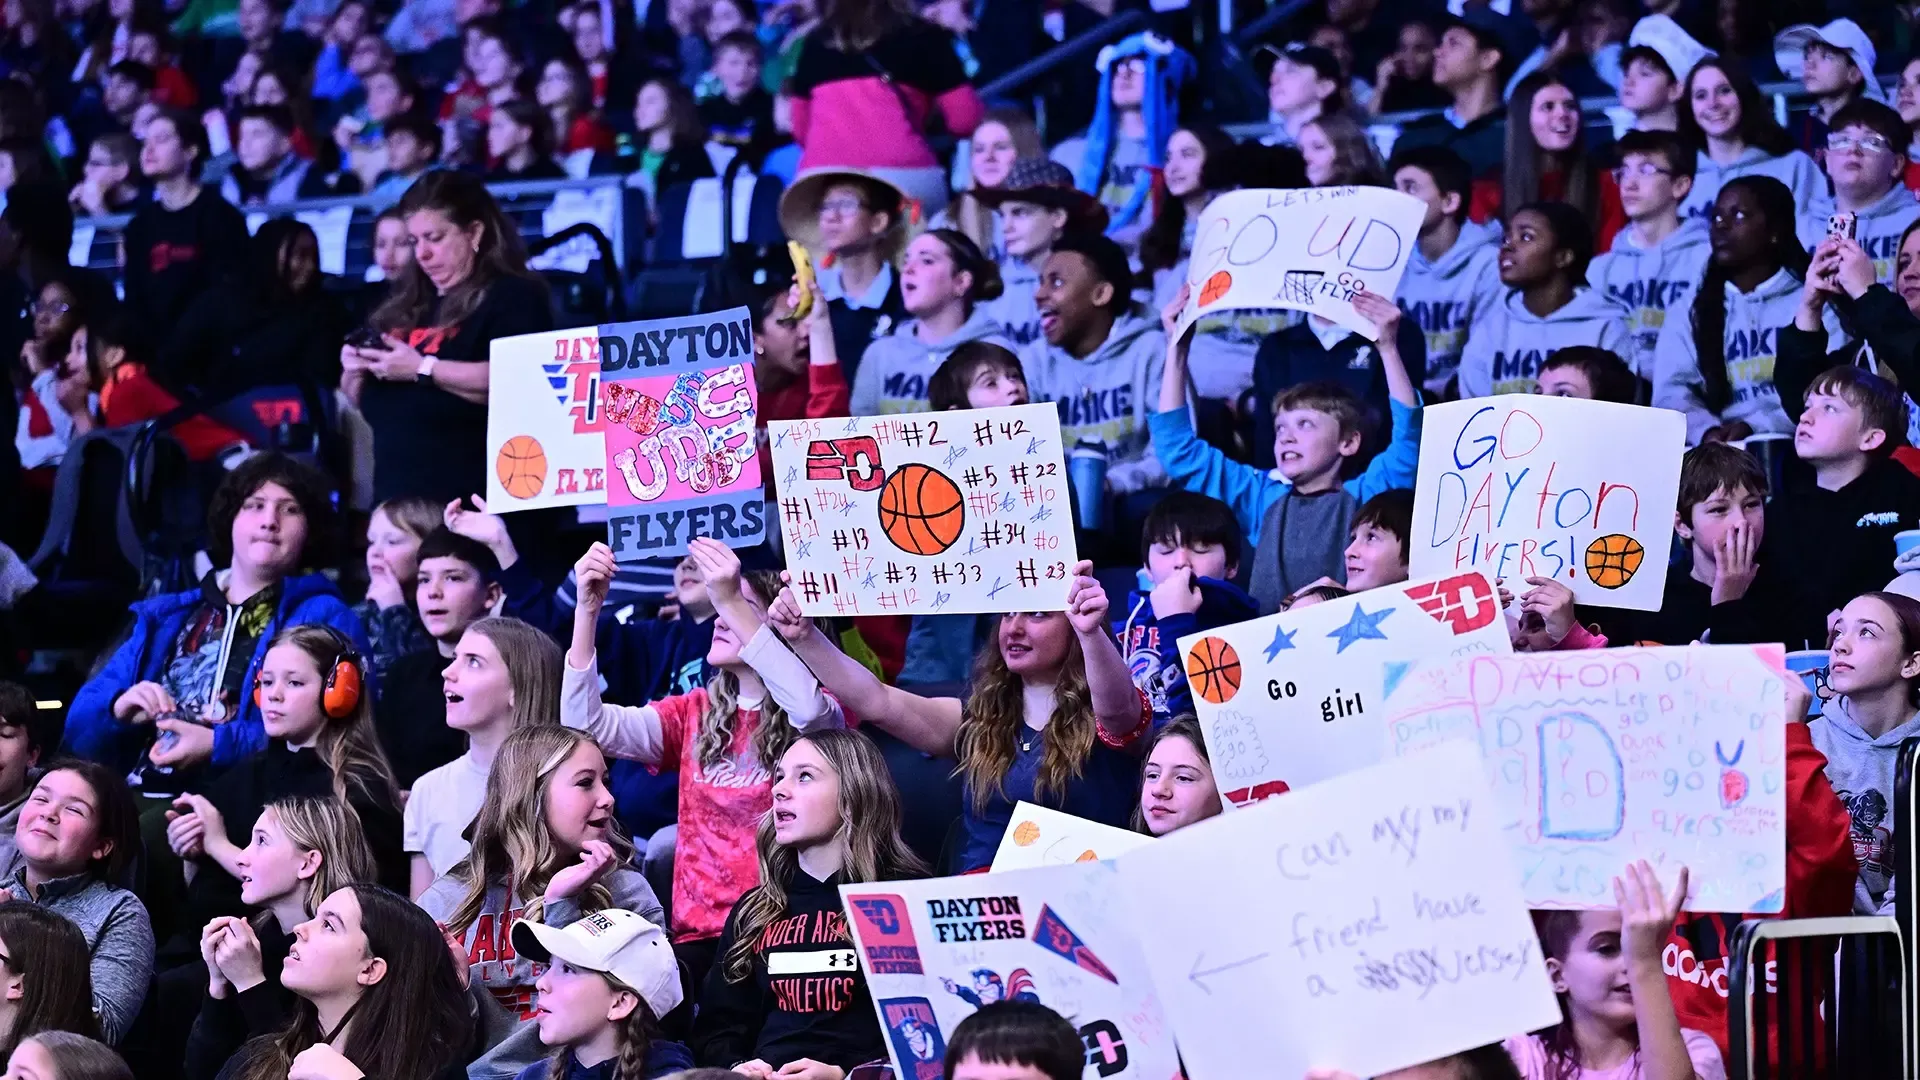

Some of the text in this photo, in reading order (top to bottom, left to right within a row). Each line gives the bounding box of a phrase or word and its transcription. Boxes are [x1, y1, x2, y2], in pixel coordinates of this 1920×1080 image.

[1267, 190, 1324, 209] LETS
[1307, 214, 1401, 272] UD
[1338, 272, 1365, 292] GO
[555, 337, 600, 362] DAY
[600, 319, 751, 372] DAYTON
[901, 421, 948, 447] #2
[1453, 406, 1543, 470] GO
[963, 464, 998, 488] #5
[1020, 484, 1056, 507] #10
[781, 496, 813, 523] #1
[609, 500, 764, 551] FLYERS
[981, 520, 1026, 548] #34
[832, 527, 870, 551] #13
[798, 569, 839, 603] #11
[884, 561, 917, 583] #3
[1267, 679, 1297, 700] Go
[1320, 688, 1364, 723] girl
[927, 895, 1022, 920] DAYTON
[935, 919, 1026, 943] FLYERS
[1287, 889, 1487, 960] friend have
[1661, 942, 1778, 998] adids
[770, 977, 854, 1013] ATHLETICS
[1306, 974, 1340, 998] a
